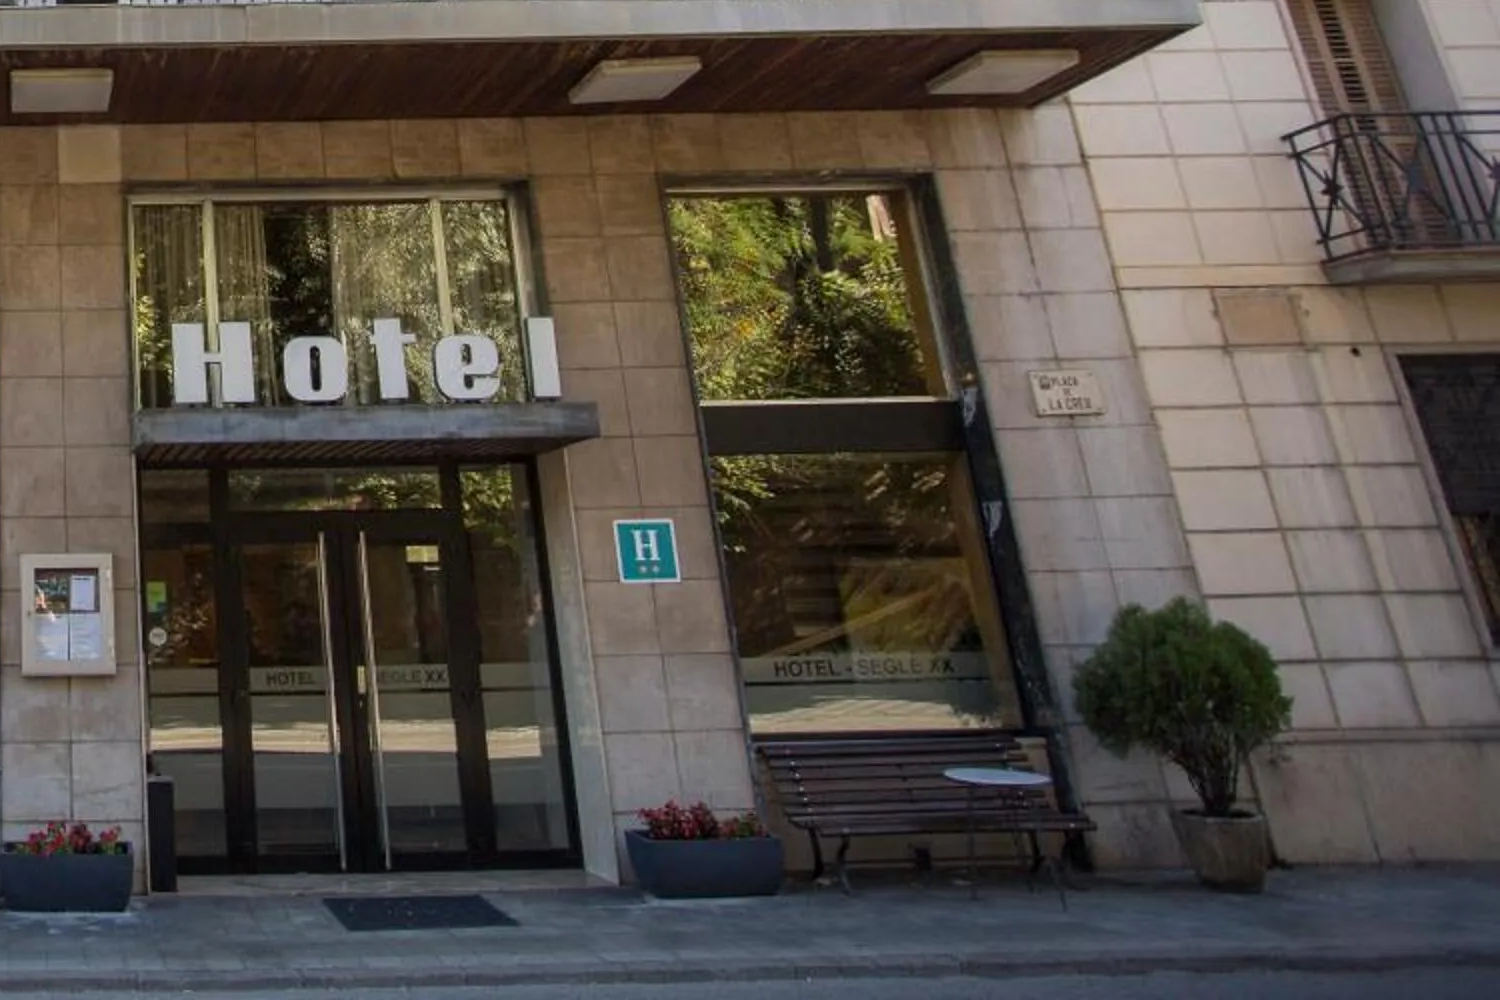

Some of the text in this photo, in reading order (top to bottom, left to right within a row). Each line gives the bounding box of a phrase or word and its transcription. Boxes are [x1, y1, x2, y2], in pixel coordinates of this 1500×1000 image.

[171, 316, 563, 404] Hotel
[630, 529, 661, 561] H
[266, 670, 316, 686] HOTEL
[424, 668, 448, 683] XX
[773, 658, 841, 678] HOTEL
[857, 656, 923, 676] SEGLE
